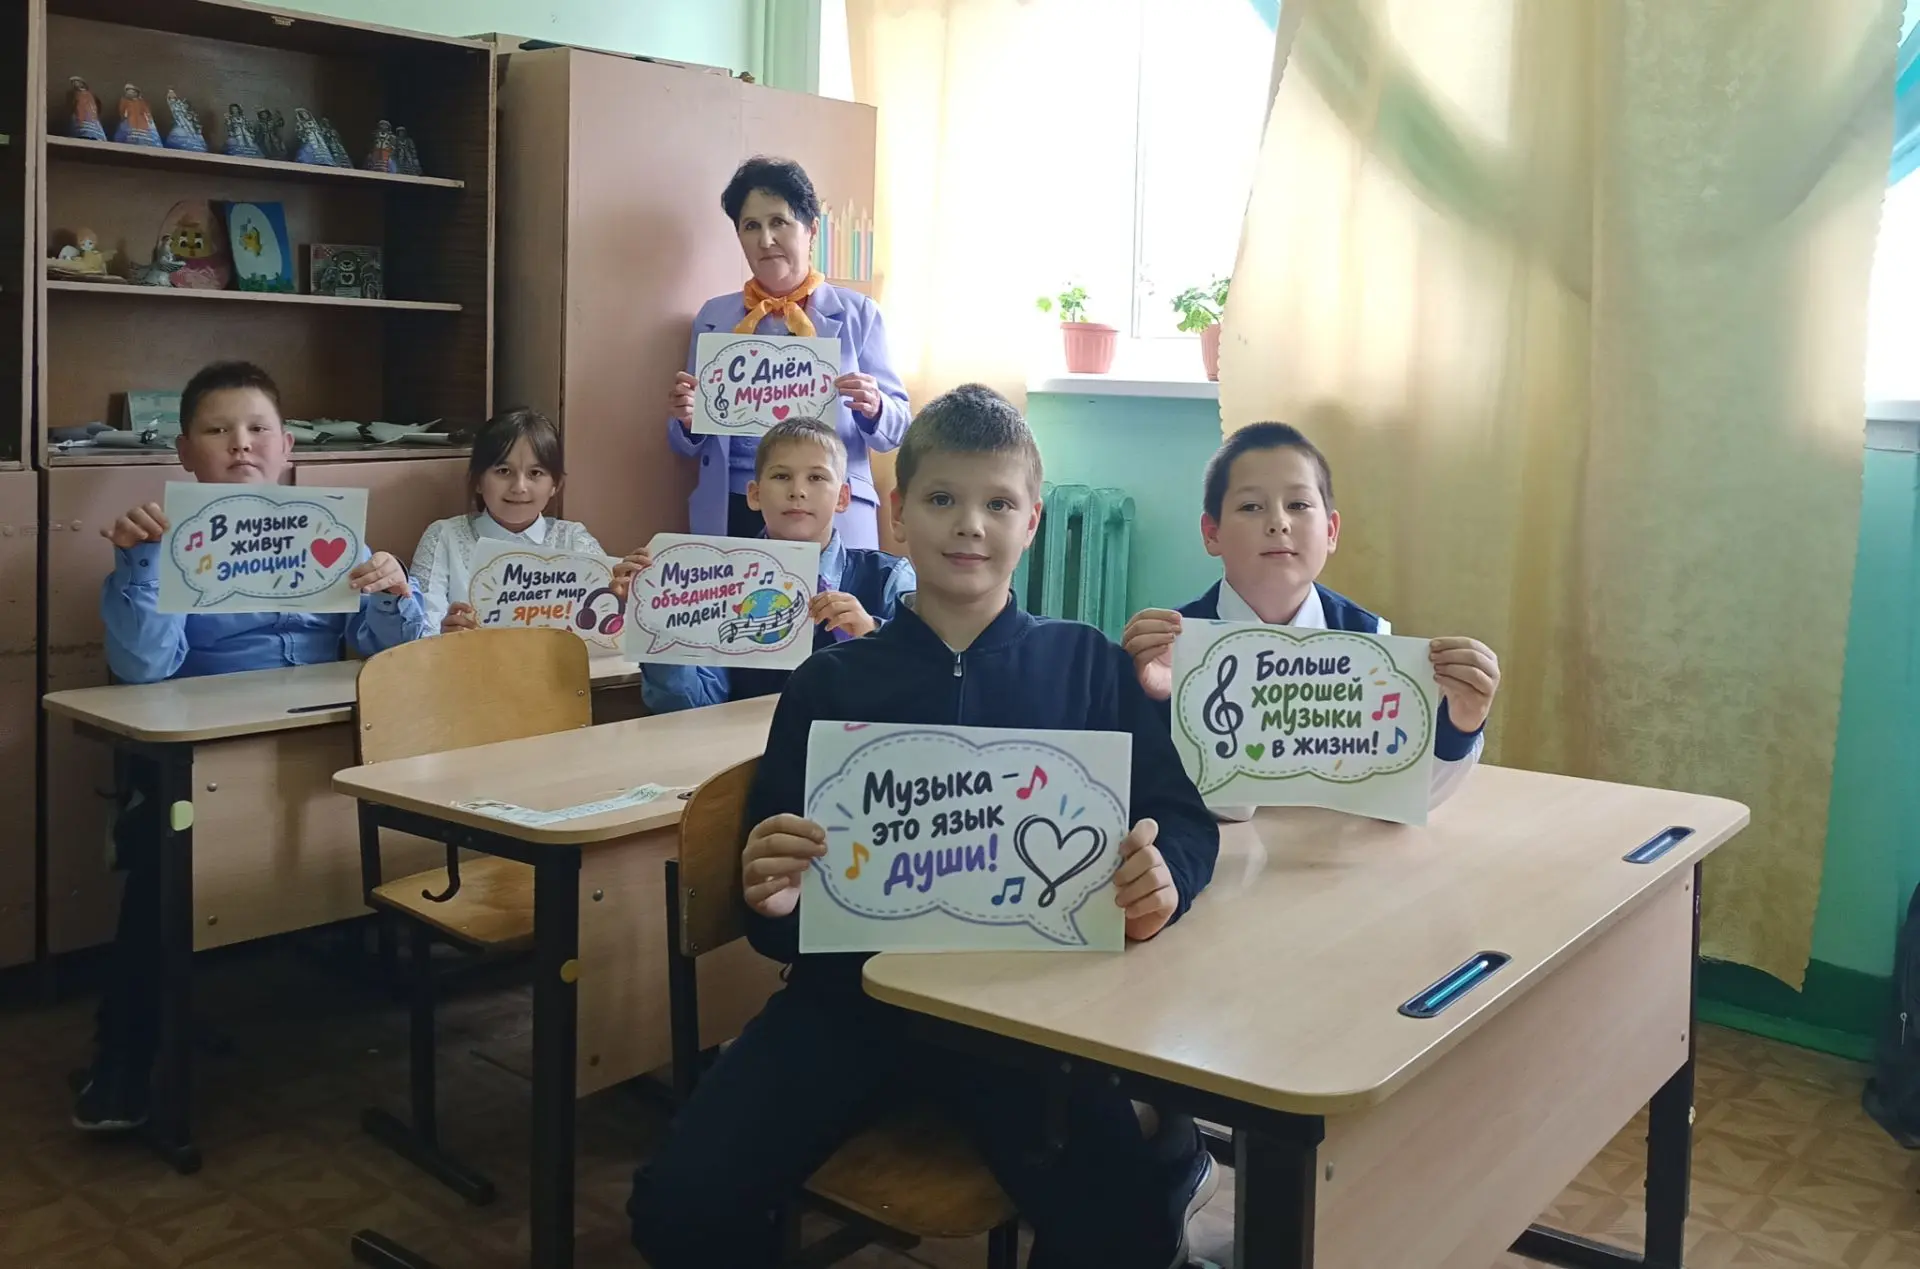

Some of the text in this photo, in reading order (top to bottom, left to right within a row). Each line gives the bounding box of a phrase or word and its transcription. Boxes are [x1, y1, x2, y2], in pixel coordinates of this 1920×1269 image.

[728, 355, 812, 385] С Днём
[734, 378, 816, 412] музыки!
[209, 514, 309, 542] В музыке
[230, 535, 295, 556] живут
[217, 549, 307, 581] эмоции!
[503, 563, 577, 589] Музыка
[660, 562, 734, 589] Музыка
[497, 587, 587, 605] делает мир
[651, 581, 745, 609] объединяет
[512, 600, 573, 625] ярче!
[666, 600, 727, 629] людей!
[1256, 650, 1351, 681] Больше
[1251, 677, 1363, 713] хорошей
[1261, 707, 1362, 736] музыки
[1272, 730, 1379, 758] в жизни!
[862, 768, 993, 816] Музыка
[872, 804, 1005, 846] это язык
